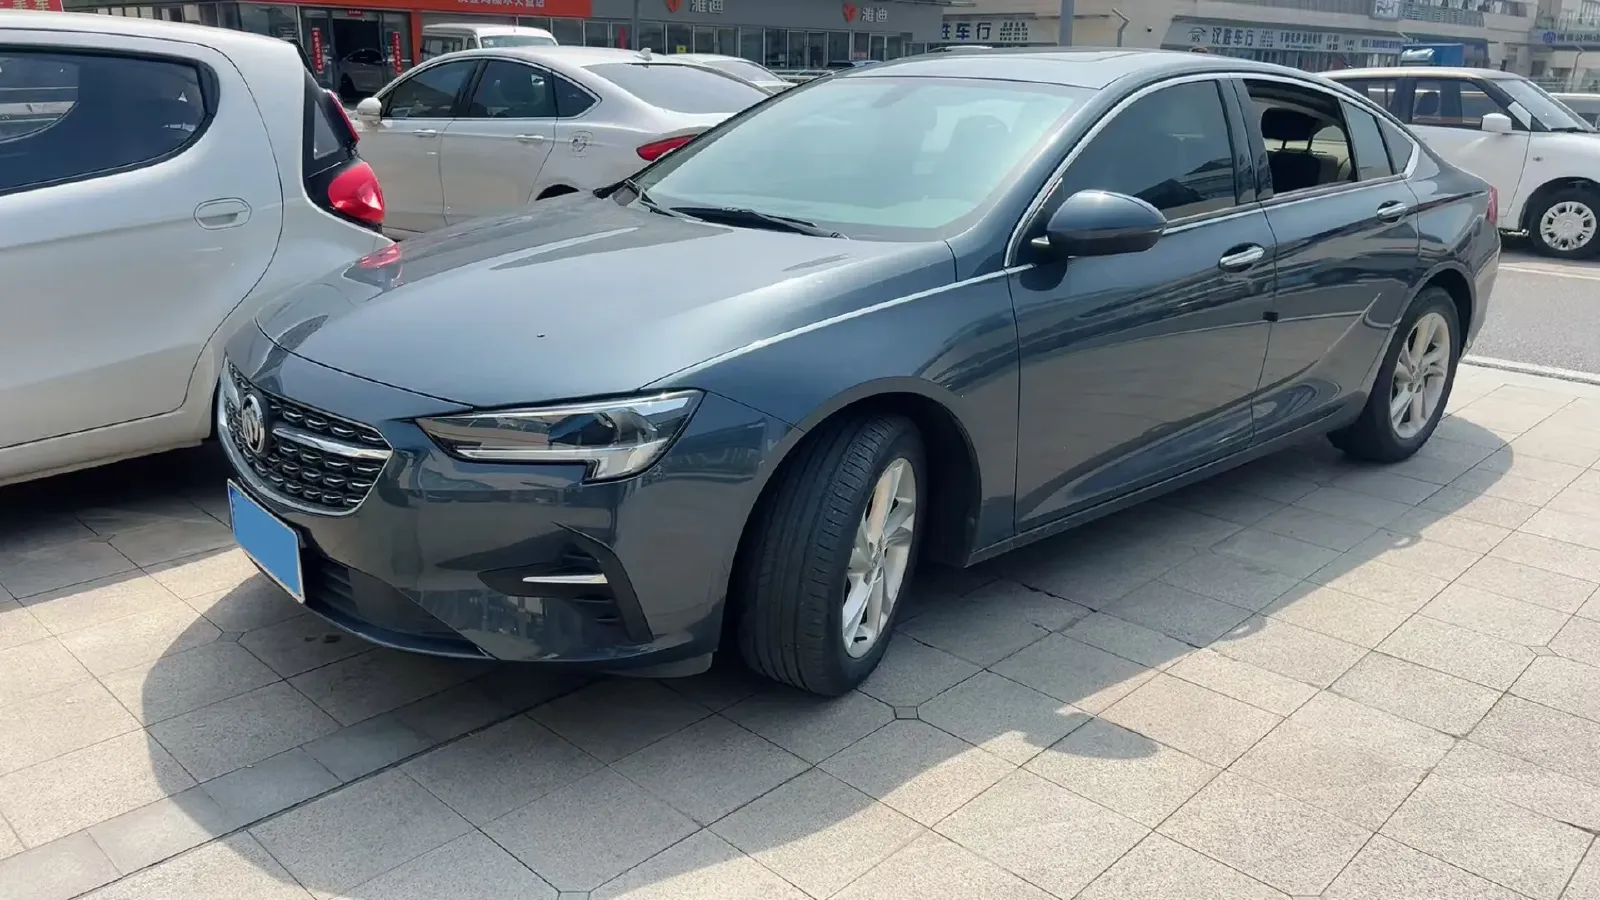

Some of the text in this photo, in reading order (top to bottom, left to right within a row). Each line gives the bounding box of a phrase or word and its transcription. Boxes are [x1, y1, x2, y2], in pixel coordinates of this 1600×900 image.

[691, 0, 724, 13] 雅迪
[862, 7, 889, 22] 雅迪
[1211, 27, 1254, 47] 汉胜车行
